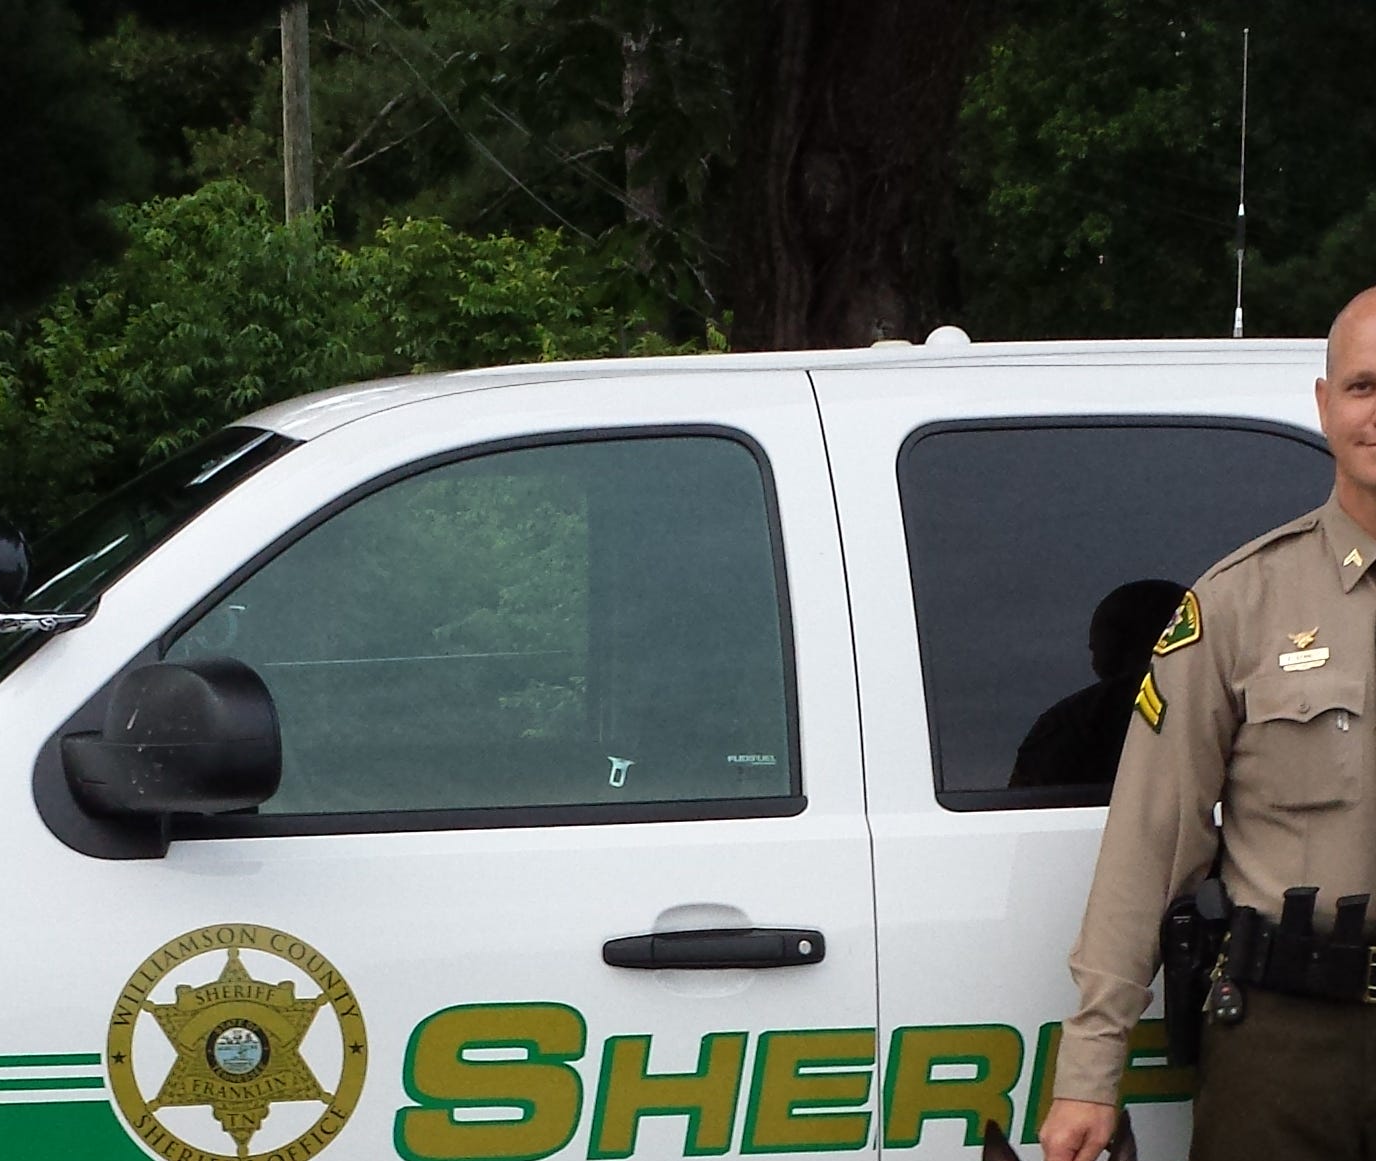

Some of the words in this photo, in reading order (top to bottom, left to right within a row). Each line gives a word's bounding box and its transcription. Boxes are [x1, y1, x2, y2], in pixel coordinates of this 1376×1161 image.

[114, 926, 256, 1027] WILLIAMSON
[270, 933, 359, 1019] COUNTY
[195, 984, 277, 1004] SHERIFF
[192, 1073, 288, 1099] FRANKLIN
[226, 1112, 255, 1126] TN
